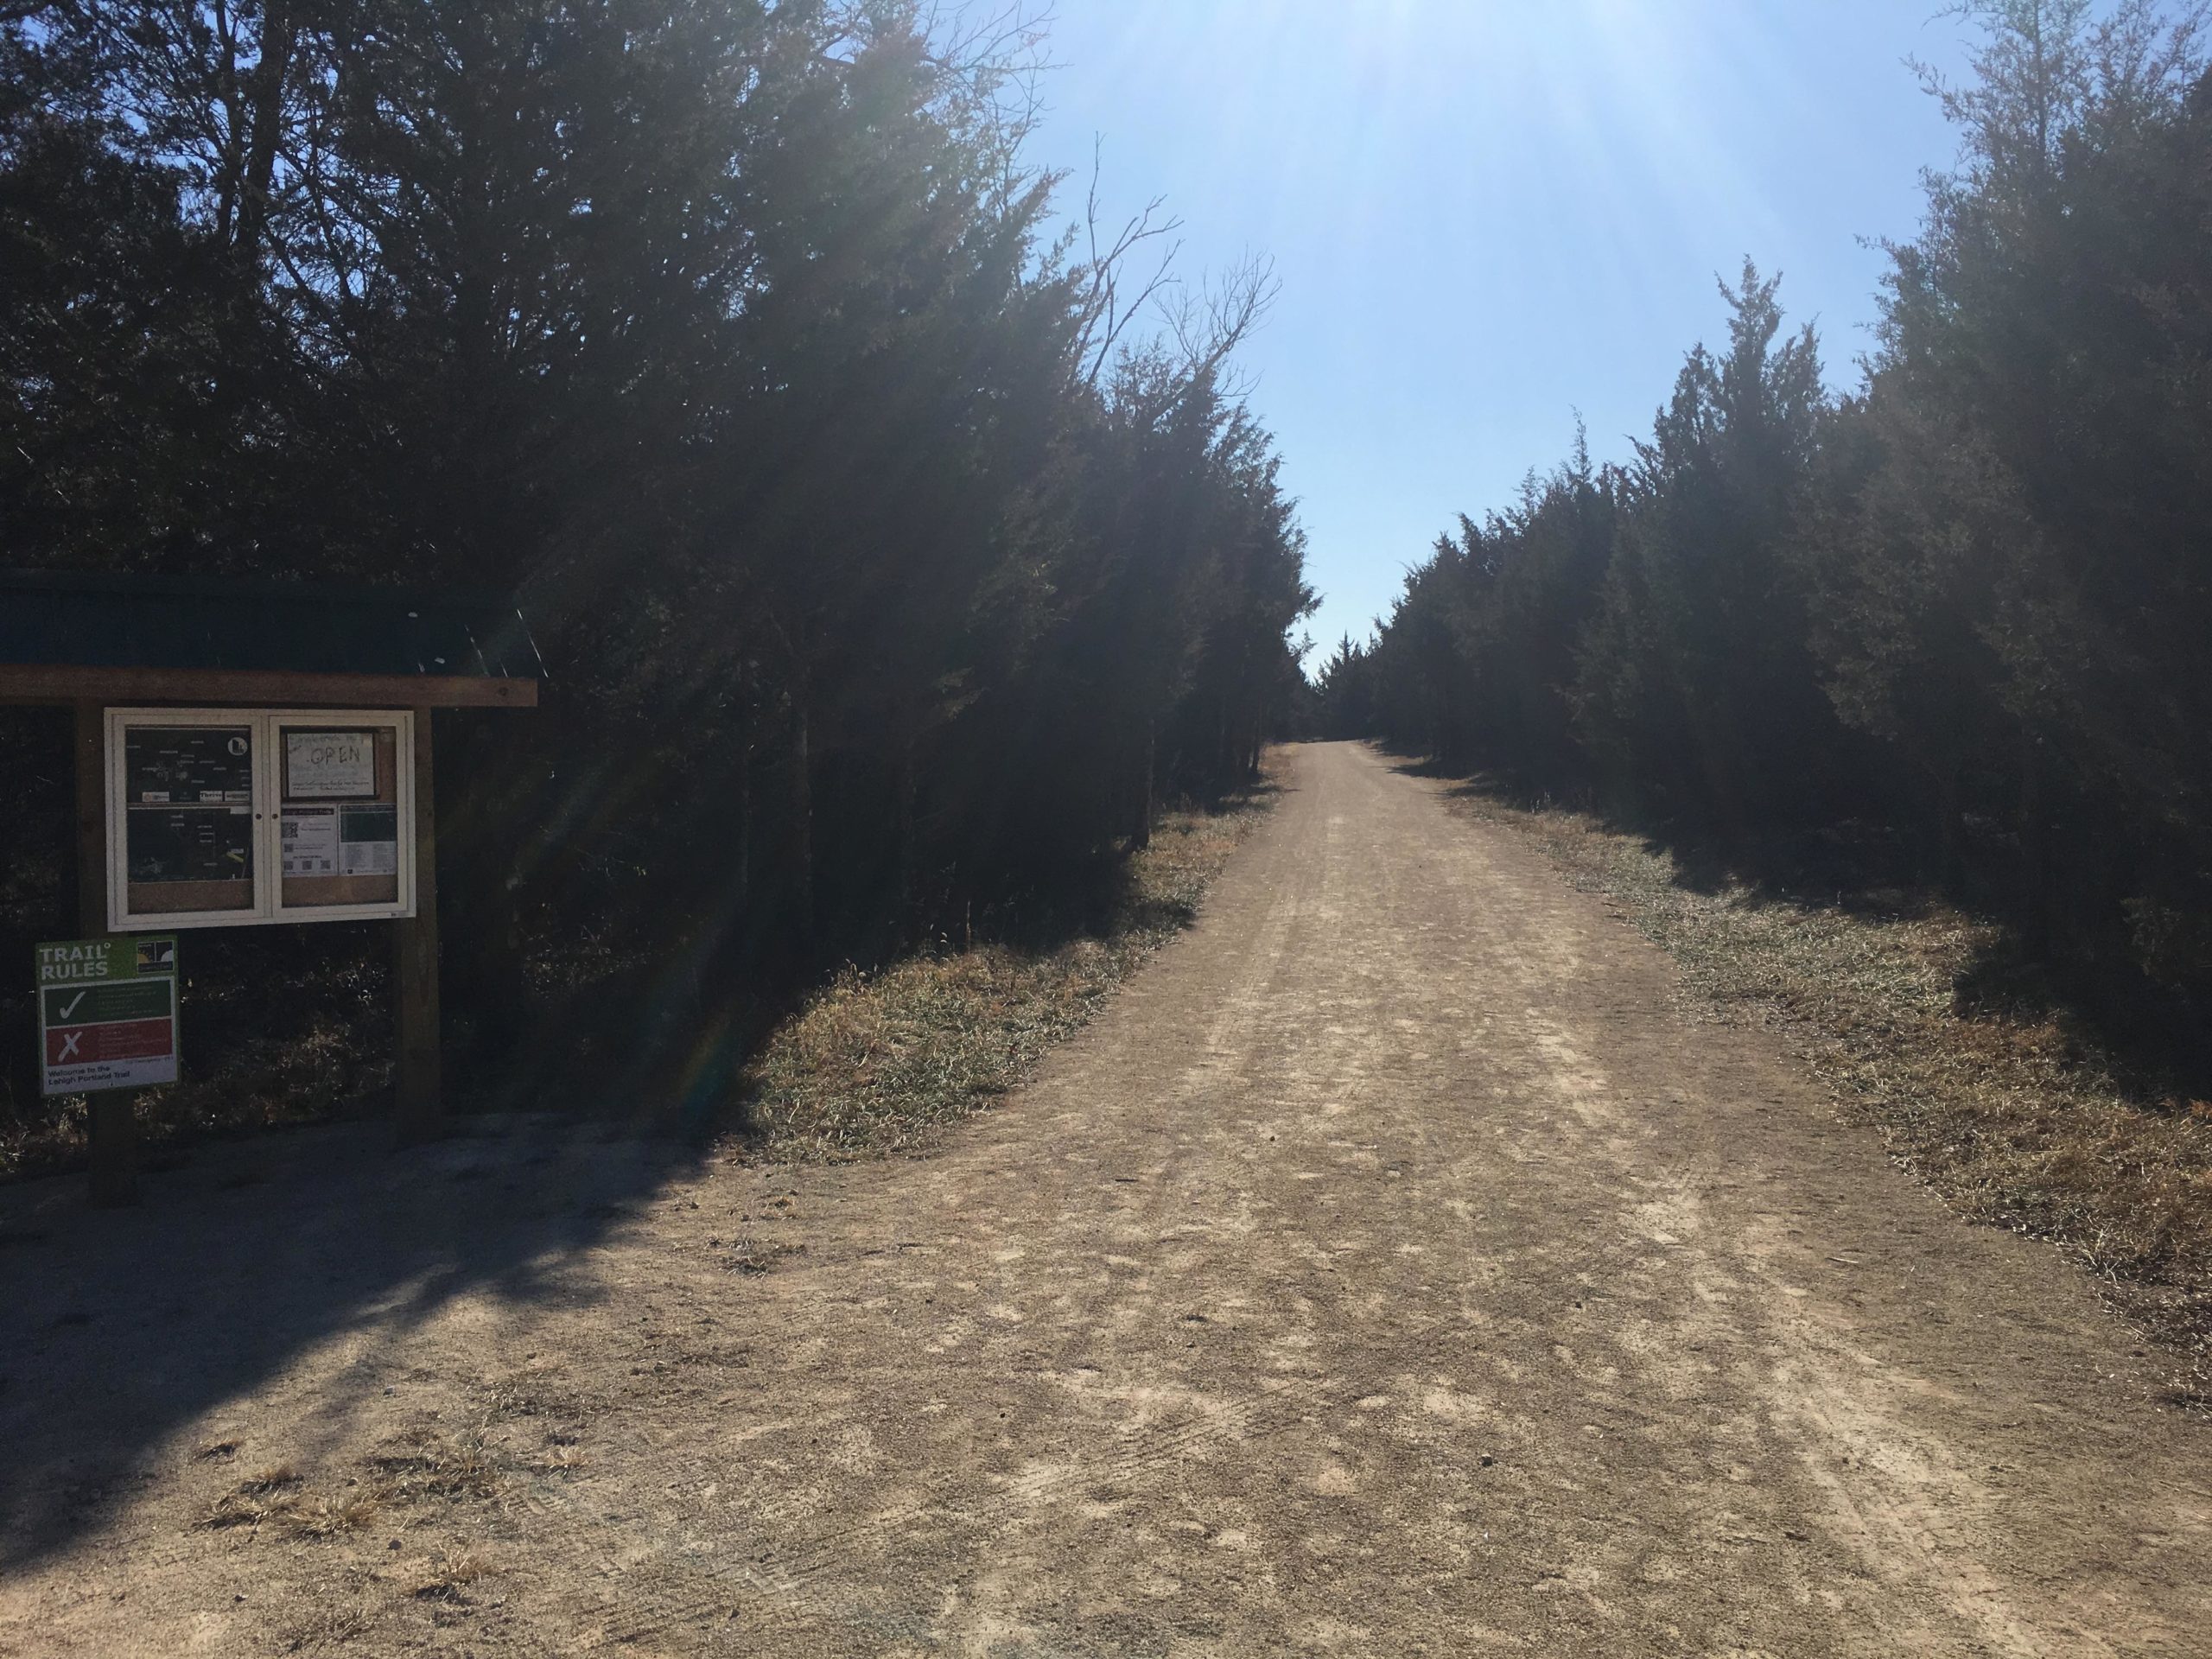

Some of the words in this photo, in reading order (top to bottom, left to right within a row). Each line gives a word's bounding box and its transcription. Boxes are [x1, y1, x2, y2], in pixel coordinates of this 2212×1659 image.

[311, 746, 359, 765] OPEN
[39, 944, 107, 963] TRAIL
[41, 961, 108, 980] RULES
[48, 1077, 76, 1085] Lehigh
[78, 1073, 111, 1082] Portland
